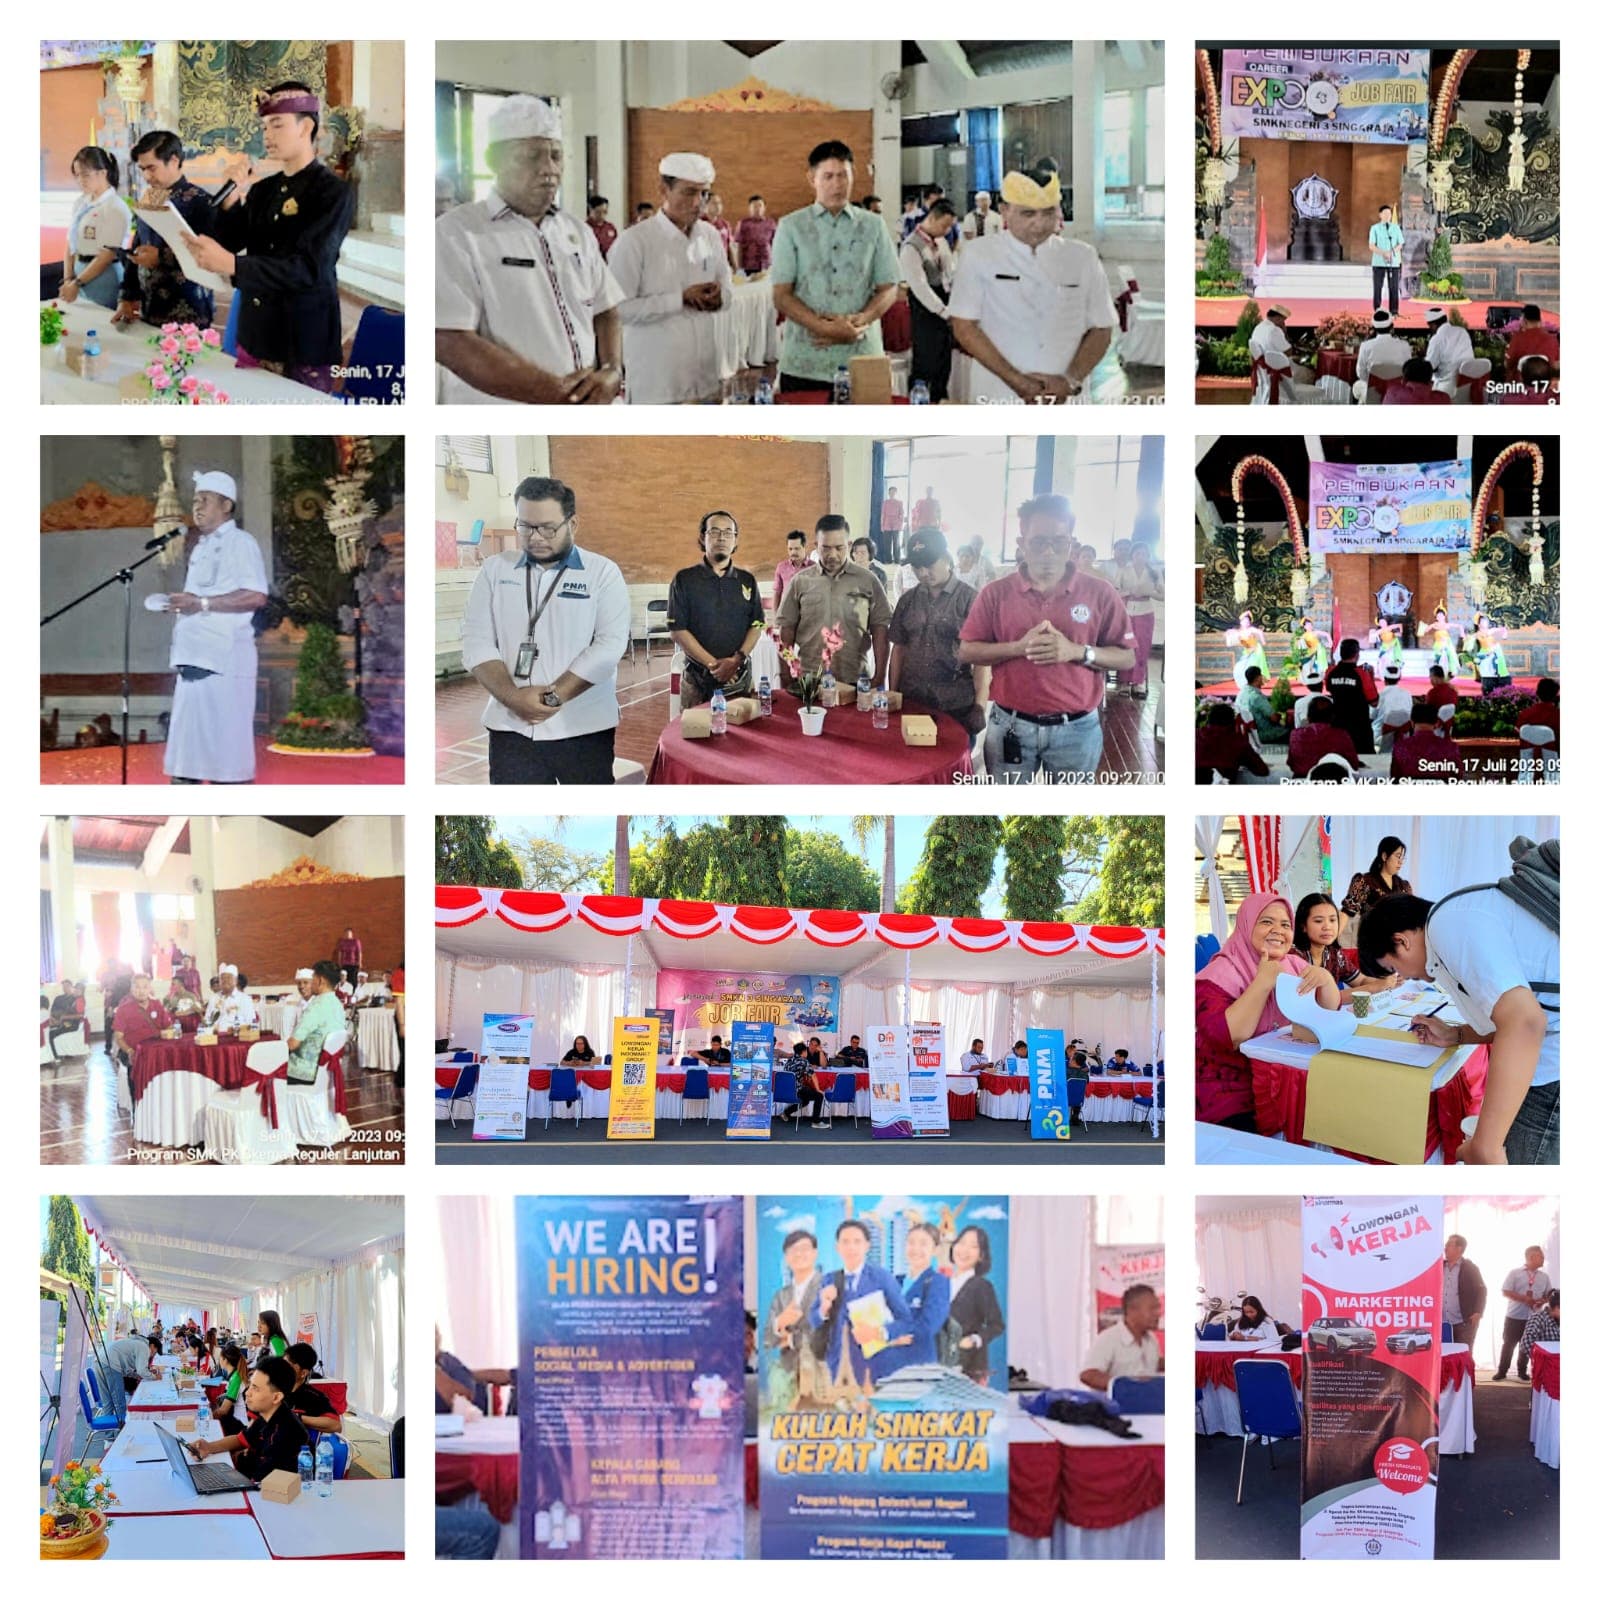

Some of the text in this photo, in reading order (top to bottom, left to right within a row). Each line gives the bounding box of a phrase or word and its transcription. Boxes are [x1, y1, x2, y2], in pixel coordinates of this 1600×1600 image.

[1231, 75, 1306, 109] EXPO
[1351, 83, 1416, 103] JOB FAIR
[1324, 478, 1456, 492] PEMBUKAAN
[1316, 505, 1373, 530] EXPO
[563, 582, 586, 590] PNM
[709, 1003, 781, 1026] JOB FAIR
[919, 1055, 939, 1065] HIRING
[1036, 1048, 1053, 1099] PNM
[1351, 1204, 1420, 1235] LOWONGAN
[544, 1218, 699, 1255] WE ARE
[1346, 1215, 1433, 1257] KERJA
[1334, 1295, 1434, 1308] MARKETING
[1355, 1310, 1433, 1328] MOBIL
[771, 1412, 869, 1440] KULIAH
[873, 1409, 995, 1440] SINGKAT
[775, 1440, 990, 1474] CEPAT KERJA
[1377, 1468, 1424, 1484] Welcome
[797, 1494, 837, 1507] Program
[817, 1535, 857, 1548] Program
